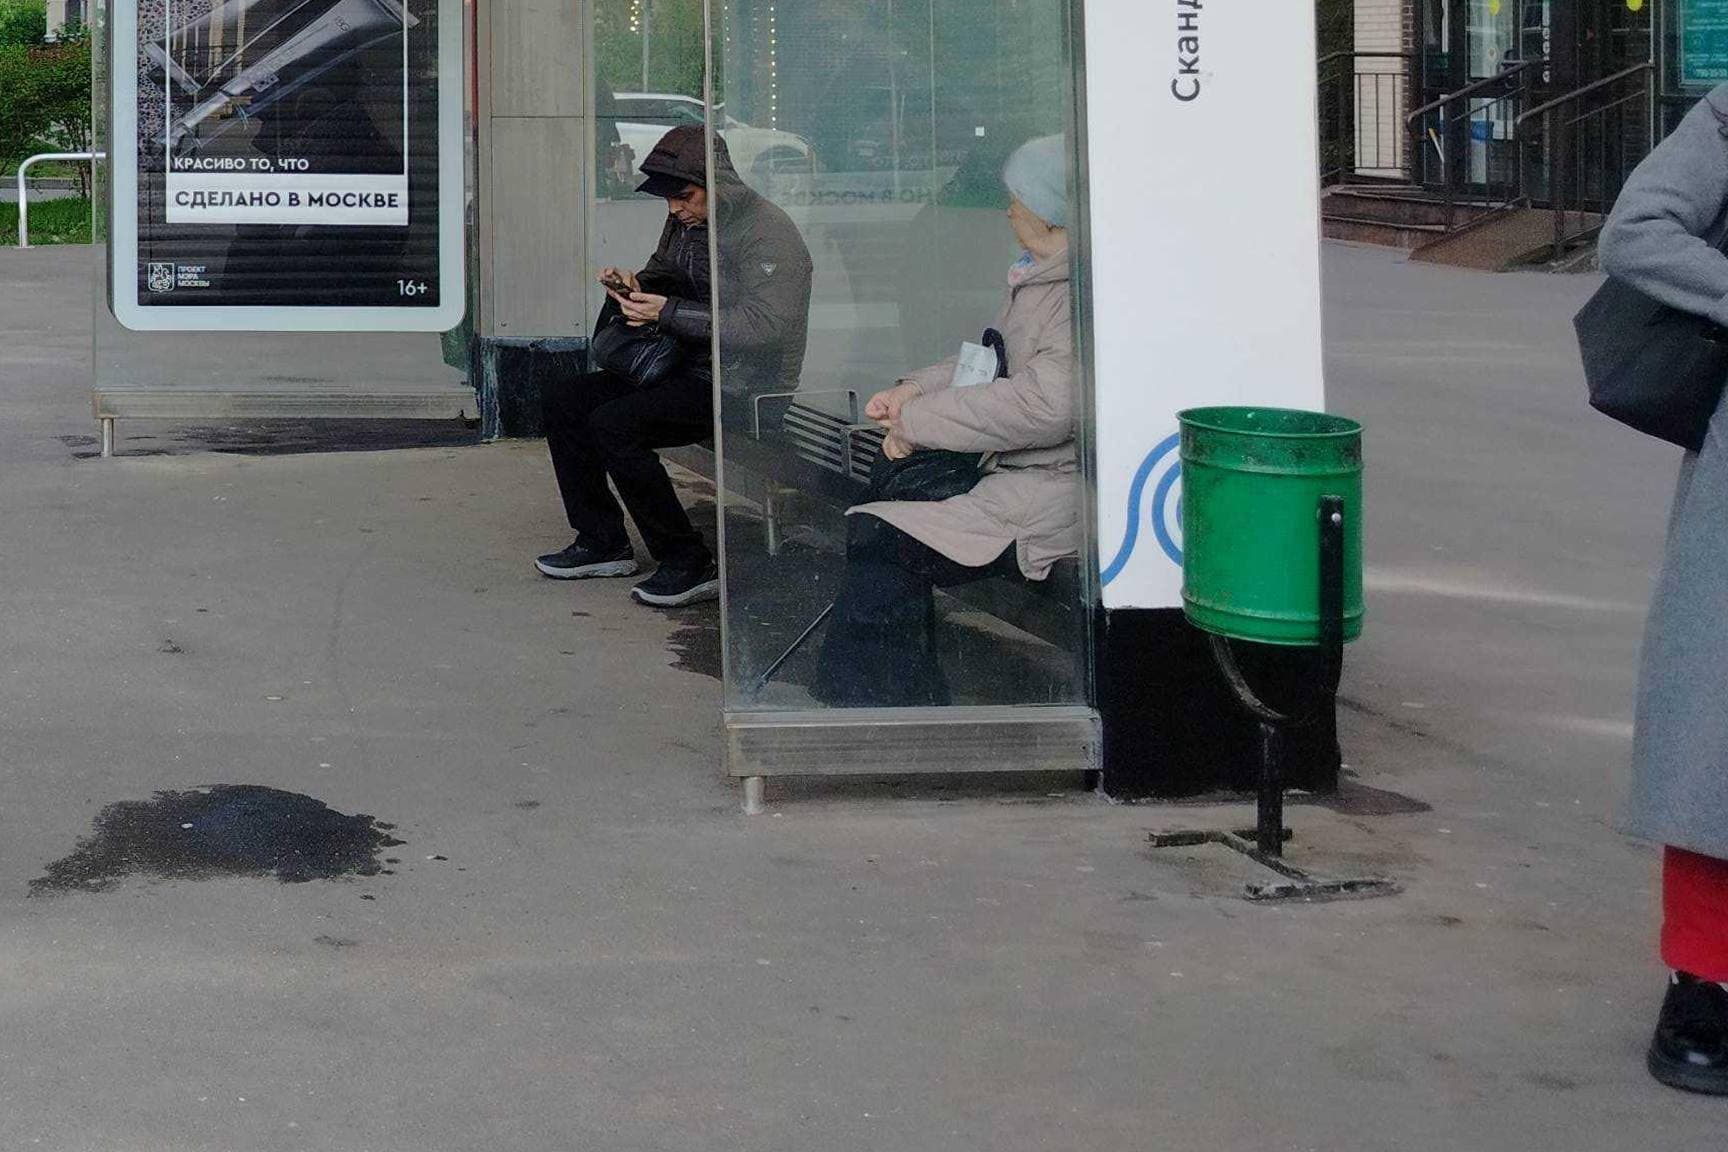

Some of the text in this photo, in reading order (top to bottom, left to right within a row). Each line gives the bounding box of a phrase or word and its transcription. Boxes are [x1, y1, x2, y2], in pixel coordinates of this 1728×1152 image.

[174, 158, 310, 172] КРАСИВО ТО, ЧТО
[175, 191, 399, 209] СДЕЛАНО В МОСКВЕ
[397, 279, 428, 296] 16+
